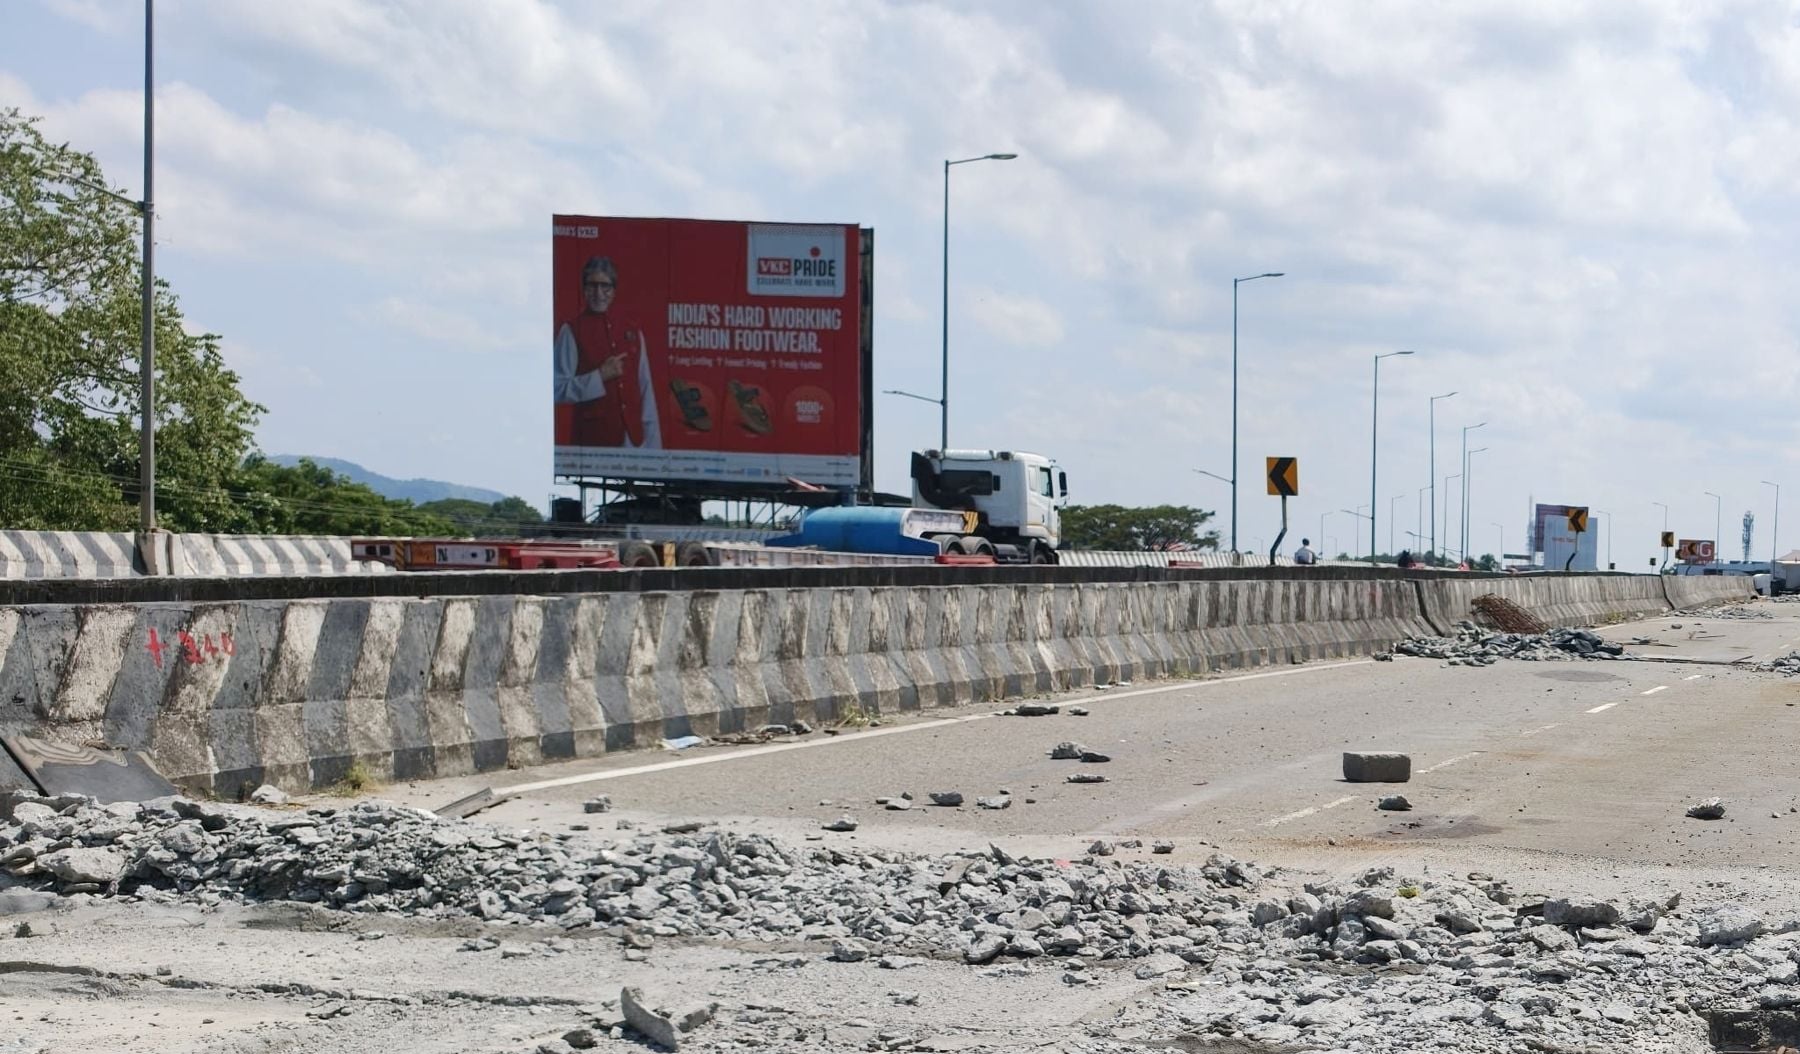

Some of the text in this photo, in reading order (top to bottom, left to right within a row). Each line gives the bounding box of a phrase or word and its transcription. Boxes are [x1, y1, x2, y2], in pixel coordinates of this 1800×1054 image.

[759, 259, 836, 277] VKC PRIDE
[668, 303, 842, 330] INDIA'S HARD WORKING
[668, 327, 822, 353] FASHION FOOTWEAR.
[437, 548, 496, 562] N P
